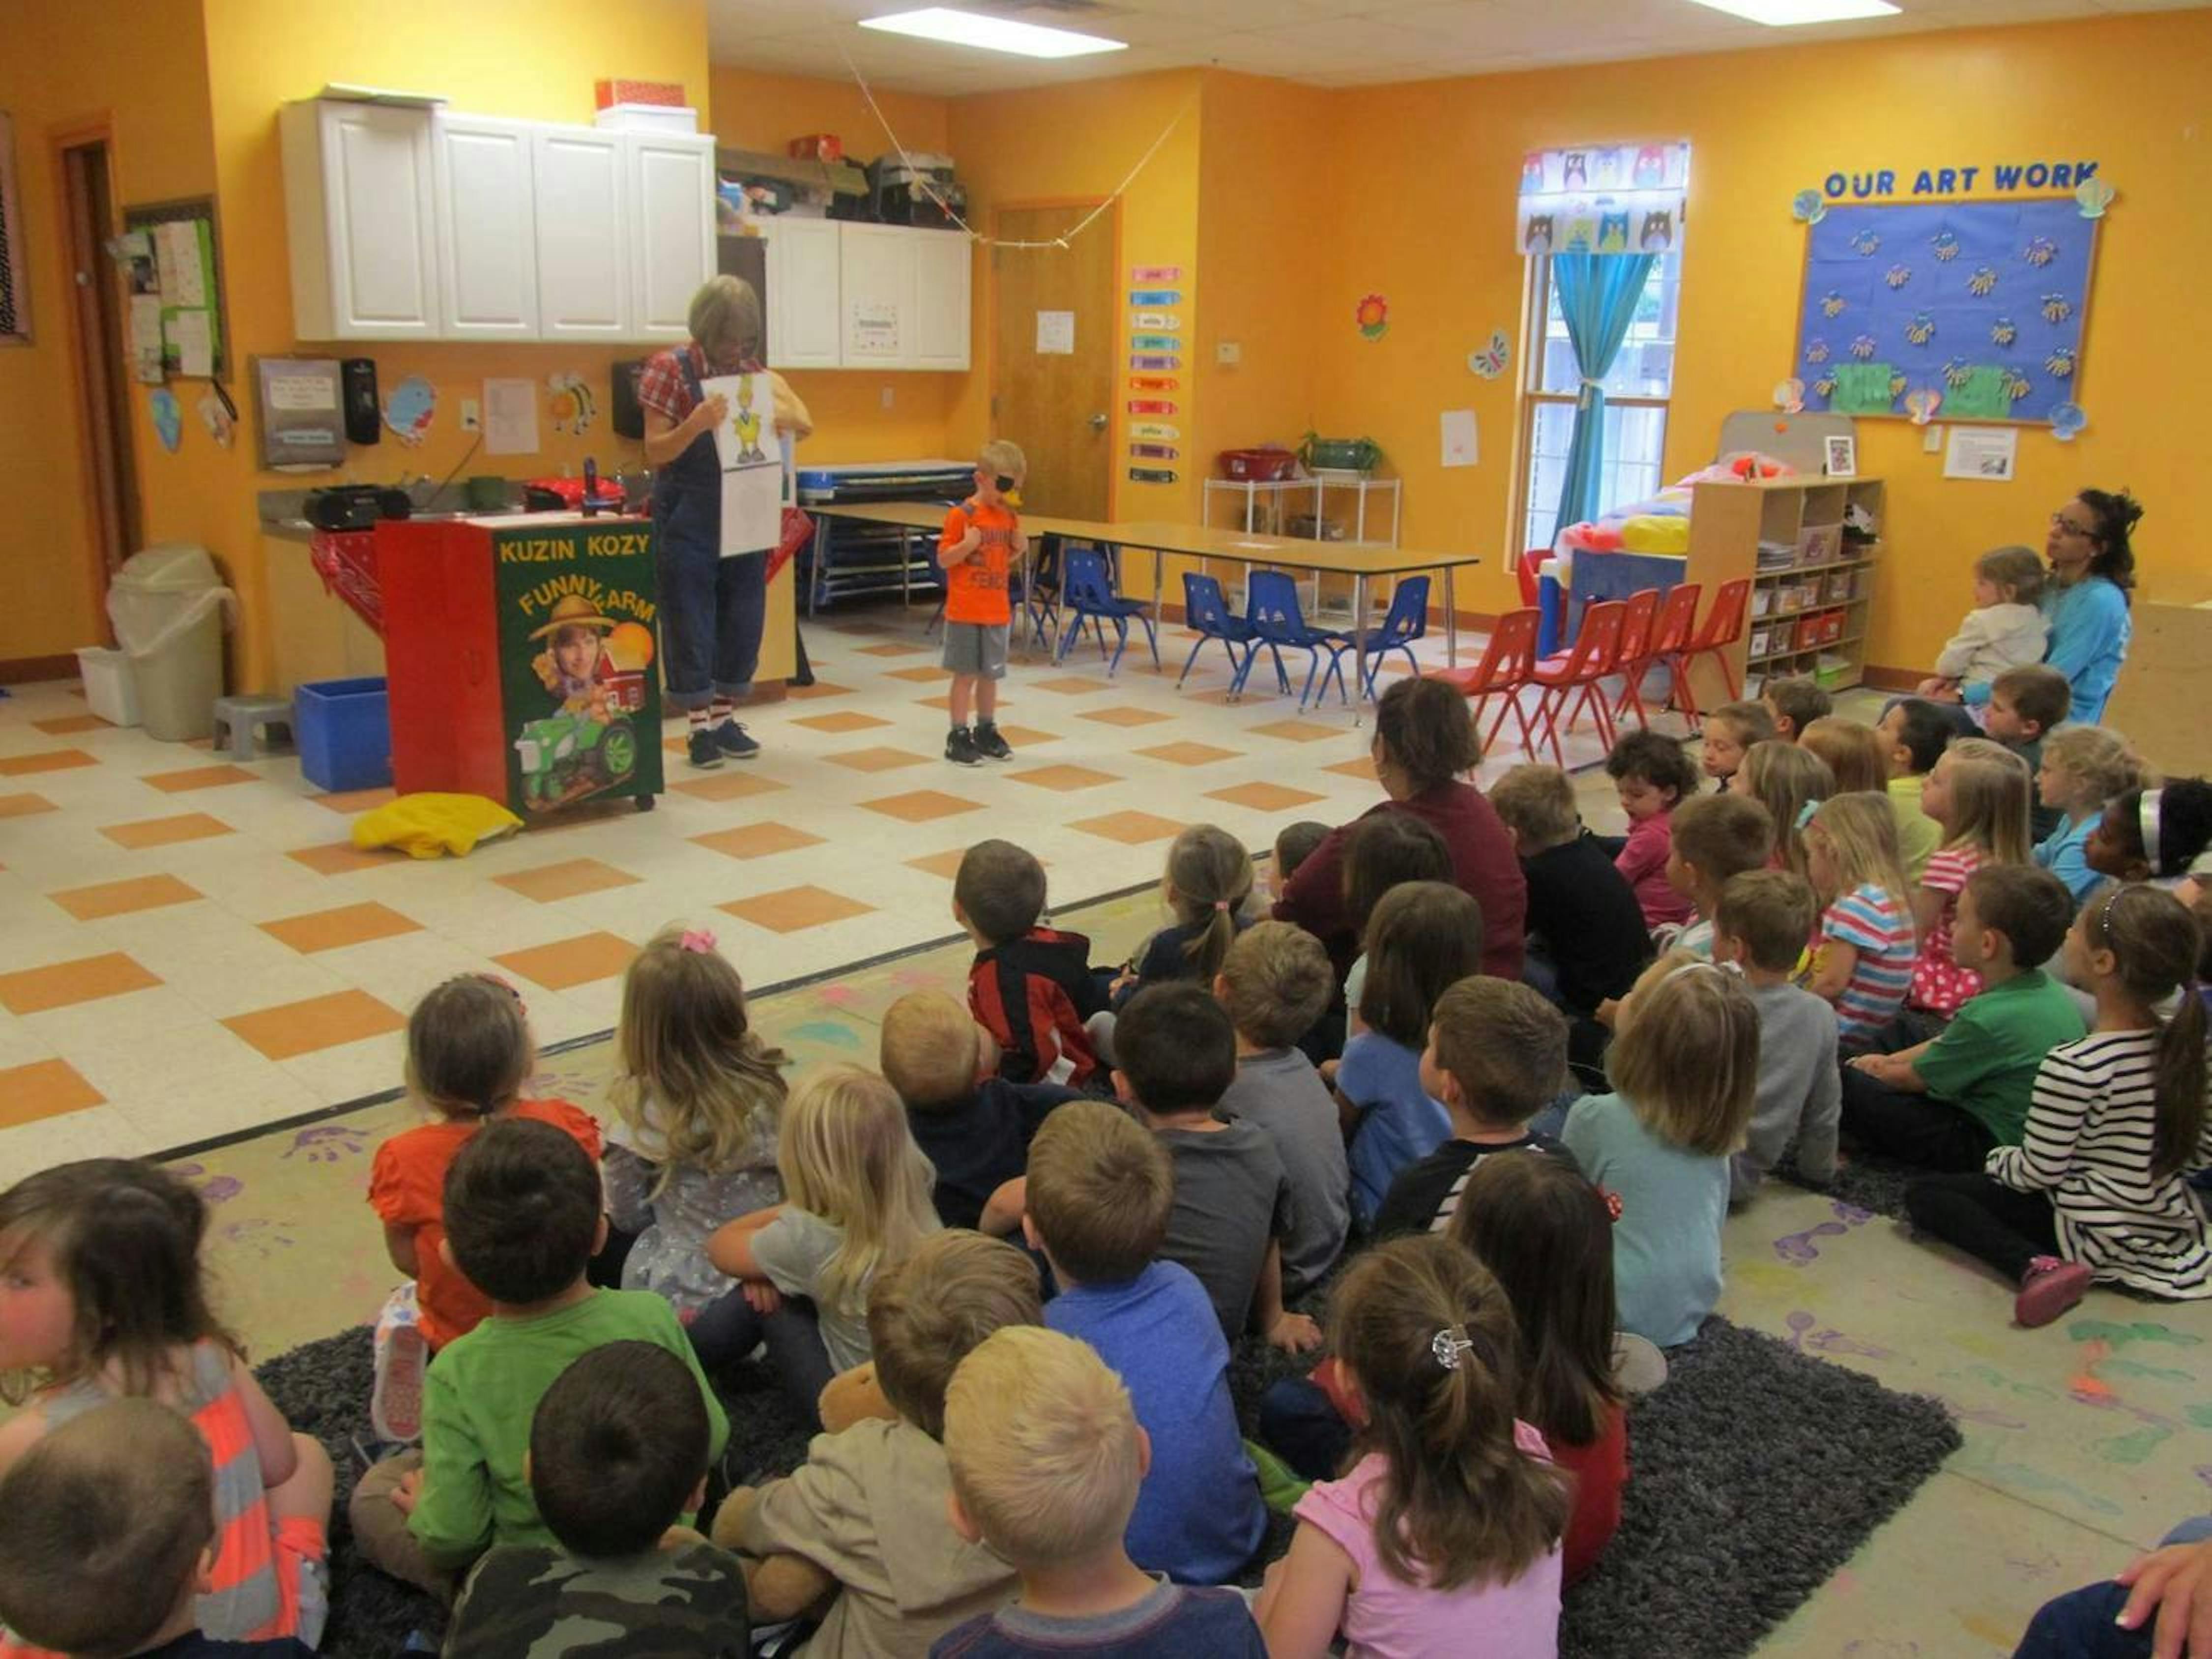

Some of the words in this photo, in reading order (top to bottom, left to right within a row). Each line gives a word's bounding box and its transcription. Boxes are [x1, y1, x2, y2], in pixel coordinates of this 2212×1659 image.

[1824, 171, 1895, 198] OUR
[1912, 168, 1979, 195] ART
[1994, 162, 2098, 190] WORK
[500, 540, 575, 562] KUZIN
[587, 534, 649, 556] KOZY
[519, 574, 603, 616] FUNNY
[592, 589, 657, 622] FARM
